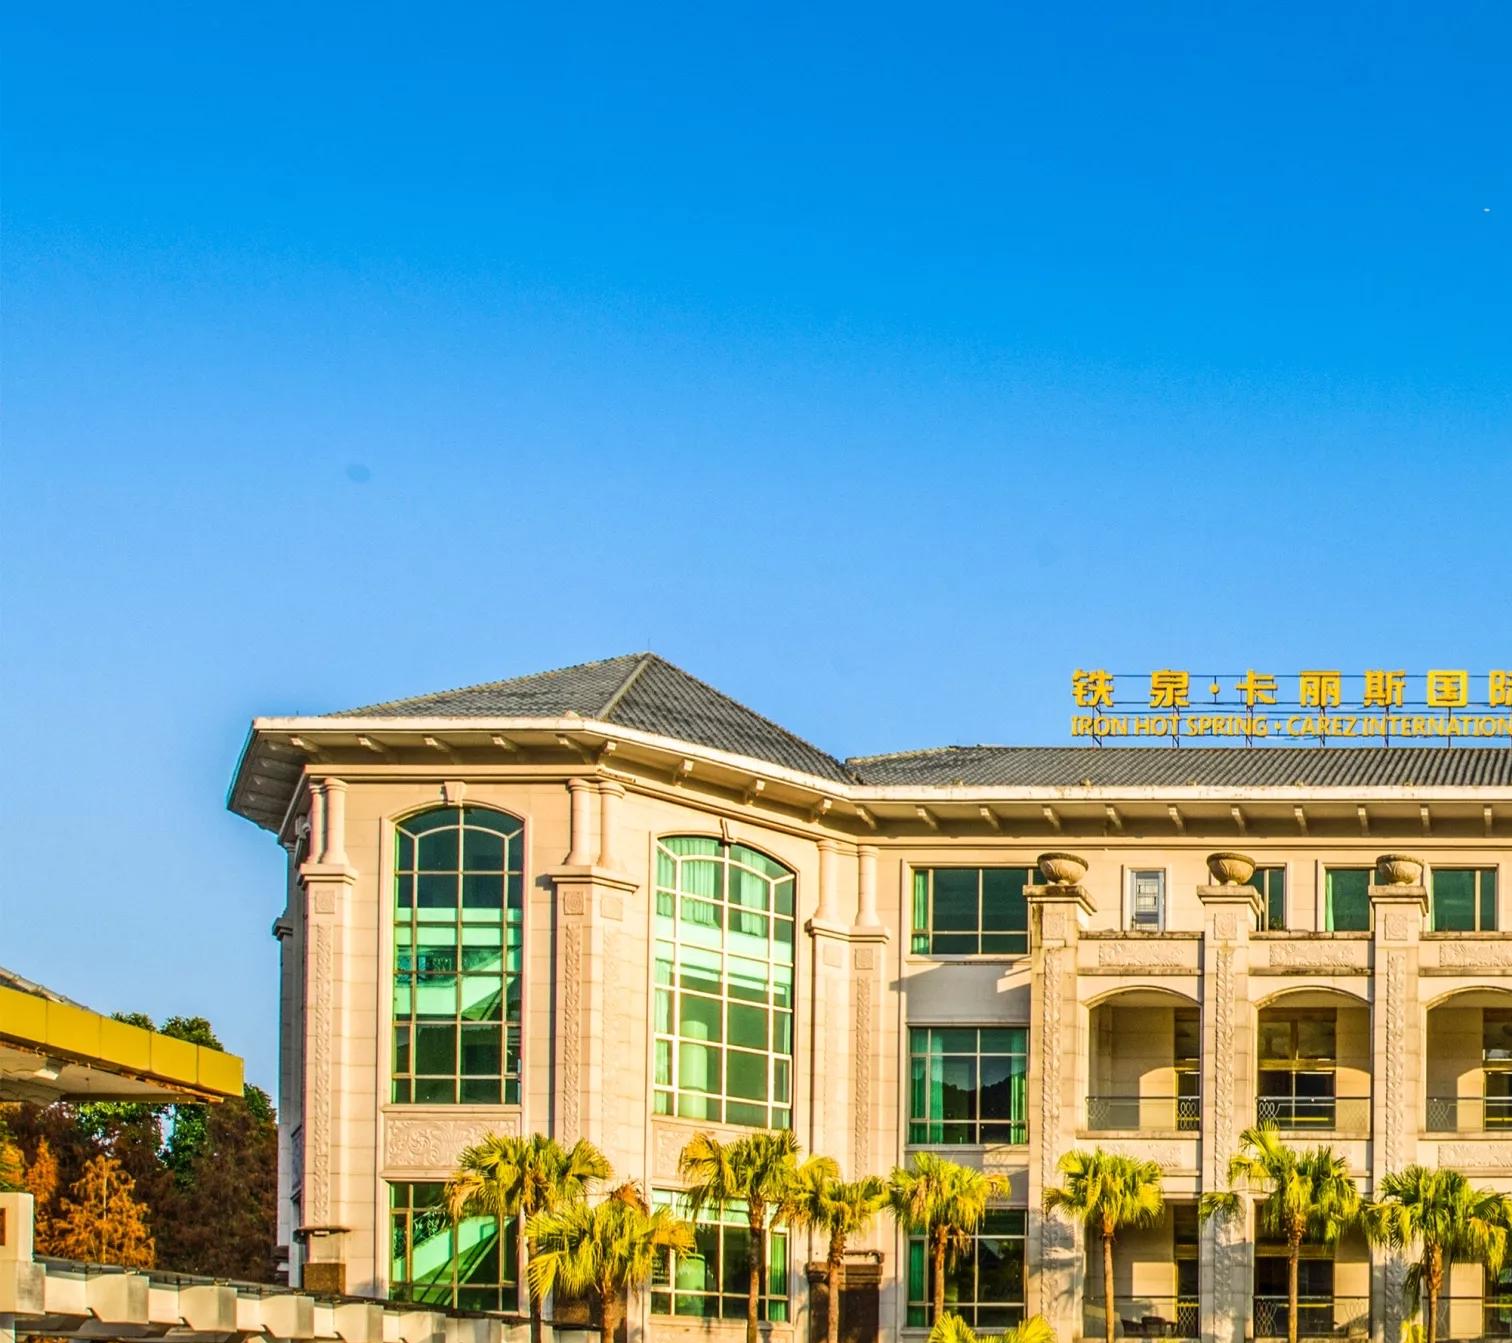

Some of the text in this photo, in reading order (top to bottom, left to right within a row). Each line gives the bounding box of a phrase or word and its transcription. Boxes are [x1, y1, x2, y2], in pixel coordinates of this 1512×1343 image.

[1071, 716, 1129, 737] IRON
[1134, 716, 1180, 737] HOT
[1187, 716, 1268, 737] SPRING
[1287, 716, 1358, 737] CAREZ
